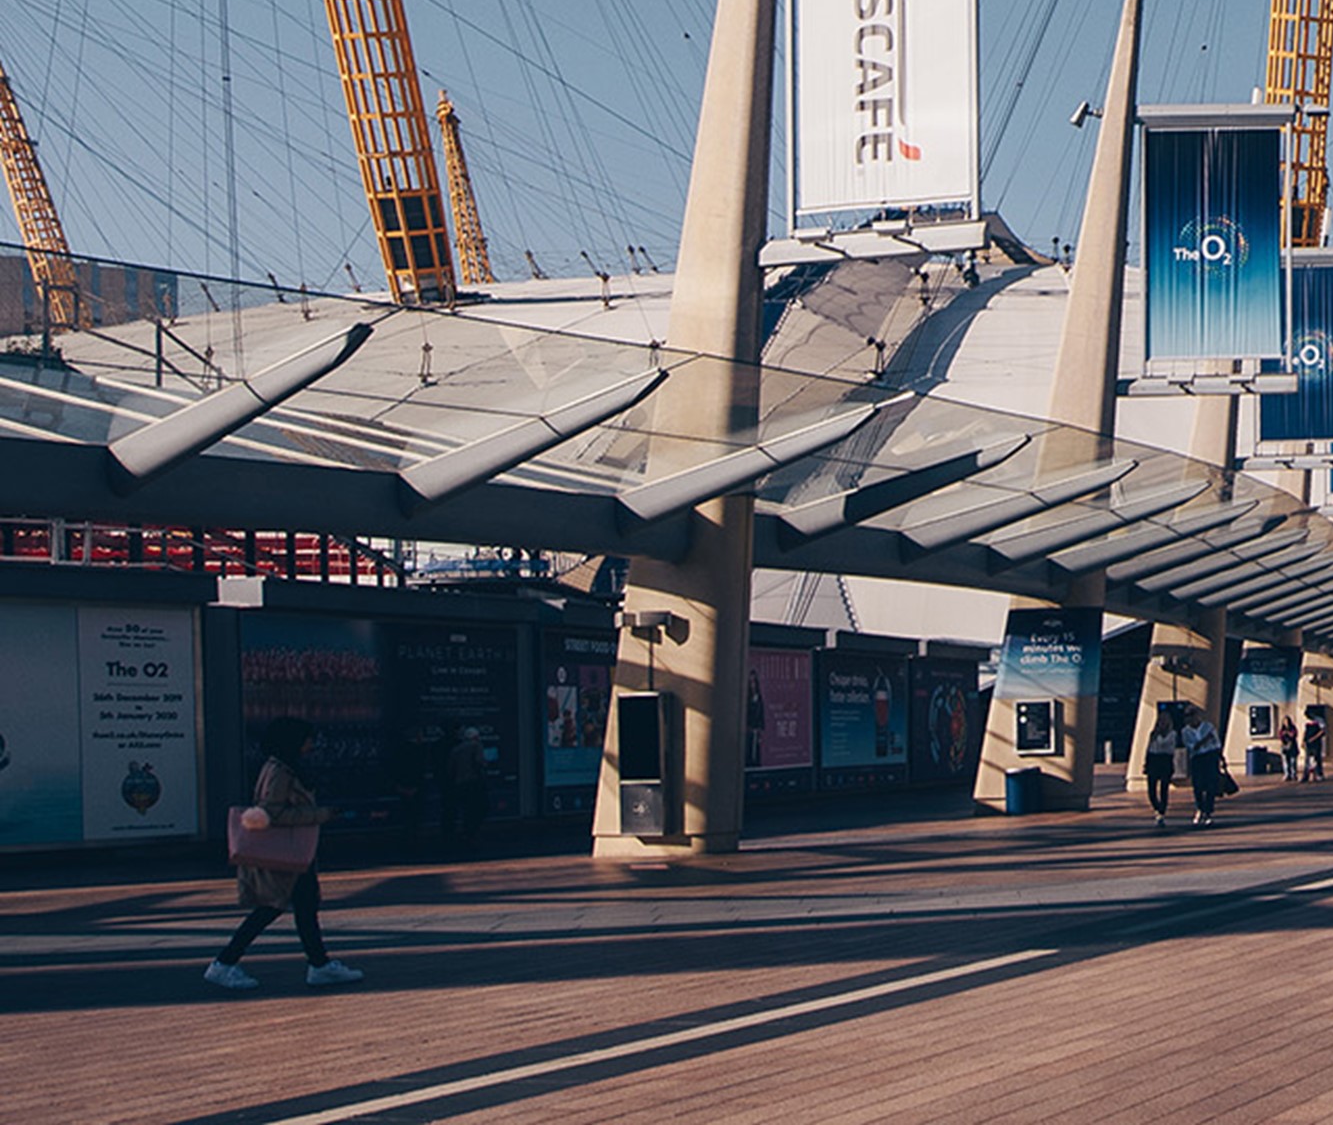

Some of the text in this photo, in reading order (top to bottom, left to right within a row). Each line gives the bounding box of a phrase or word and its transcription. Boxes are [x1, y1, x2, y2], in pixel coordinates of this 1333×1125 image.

[1173, 247, 1199, 261] The
[1022, 643, 1064, 654] minutes
[1019, 654, 1048, 665] climb
[1050, 653, 1069, 664] The
[106, 660, 169, 678] The O2
